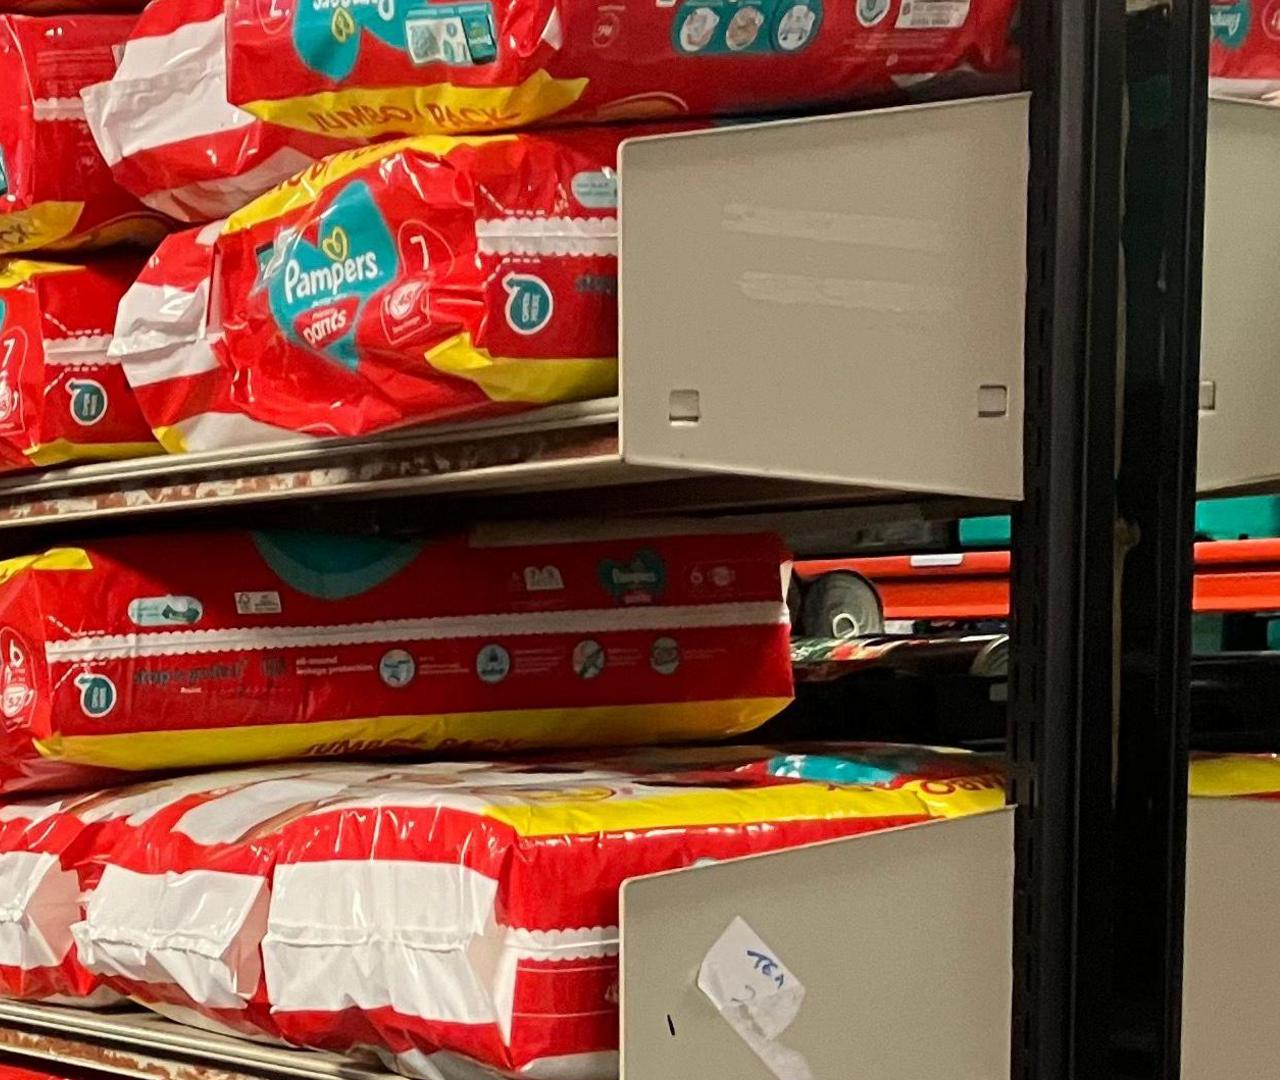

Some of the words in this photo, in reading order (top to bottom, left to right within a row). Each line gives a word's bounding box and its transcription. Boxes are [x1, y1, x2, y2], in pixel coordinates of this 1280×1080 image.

[410, 235, 430, 271] 7
[285, 252, 378, 304] Pampers
[303, 306, 346, 344] pants
[1, 338, 16, 367] 7
